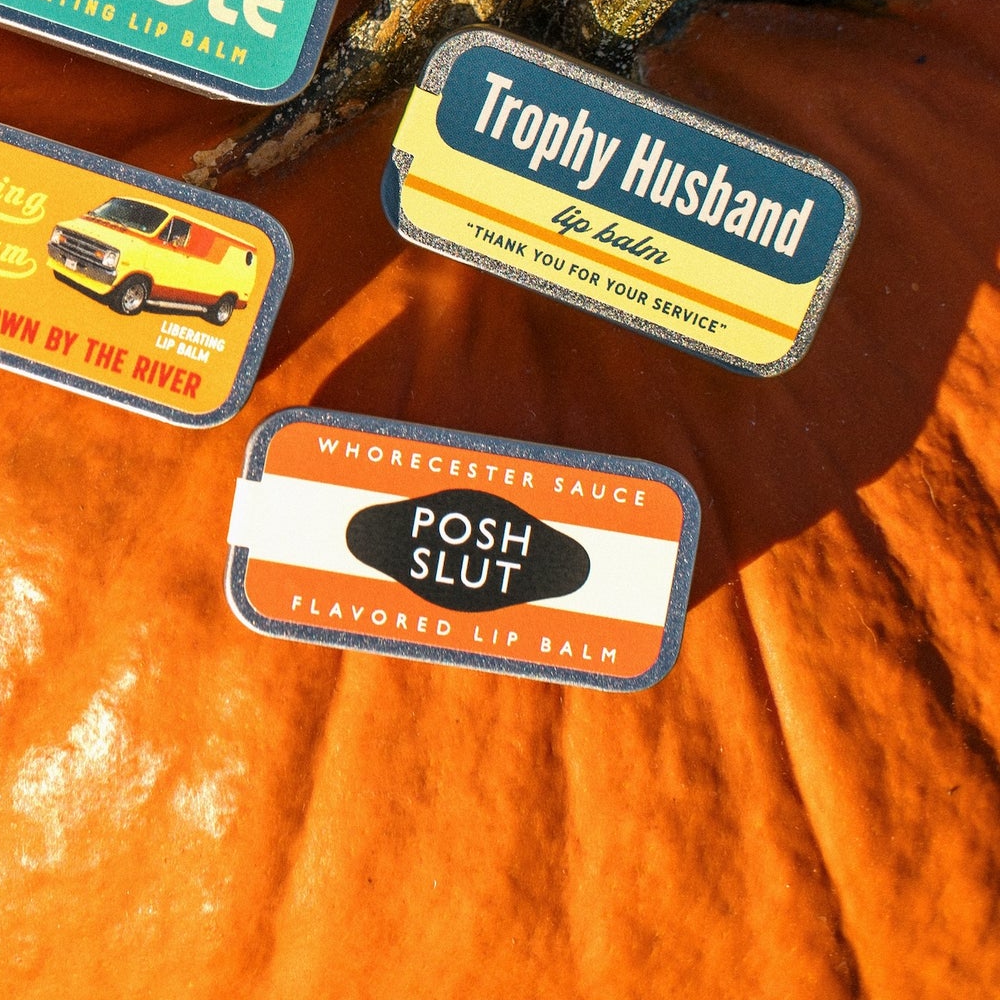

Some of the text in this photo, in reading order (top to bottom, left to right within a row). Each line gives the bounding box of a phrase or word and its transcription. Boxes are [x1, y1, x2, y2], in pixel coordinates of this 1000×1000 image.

[129, 13, 169, 39] LIP
[181, 29, 248, 66] BALM
[474, 71, 815, 257] Trophy Husband
[551, 205, 670, 266] lip balm
[533, 249, 566, 271] YOU
[568, 264, 600, 287] FOR
[606, 279, 649, 306] YOUR
[44, 326, 78, 357] BY
[82, 338, 128, 374] THE
[132, 354, 202, 400] RIVER
[155, 337, 210, 364] LIP BALM
[160, 320, 226, 352] LIBERATING
[318, 437, 646, 507] WHORECESTER SAUCE
[411, 506, 532, 557] POSH
[409, 546, 522, 594] SLUT
[291, 595, 618, 664] FLAVORED LIP BALM
